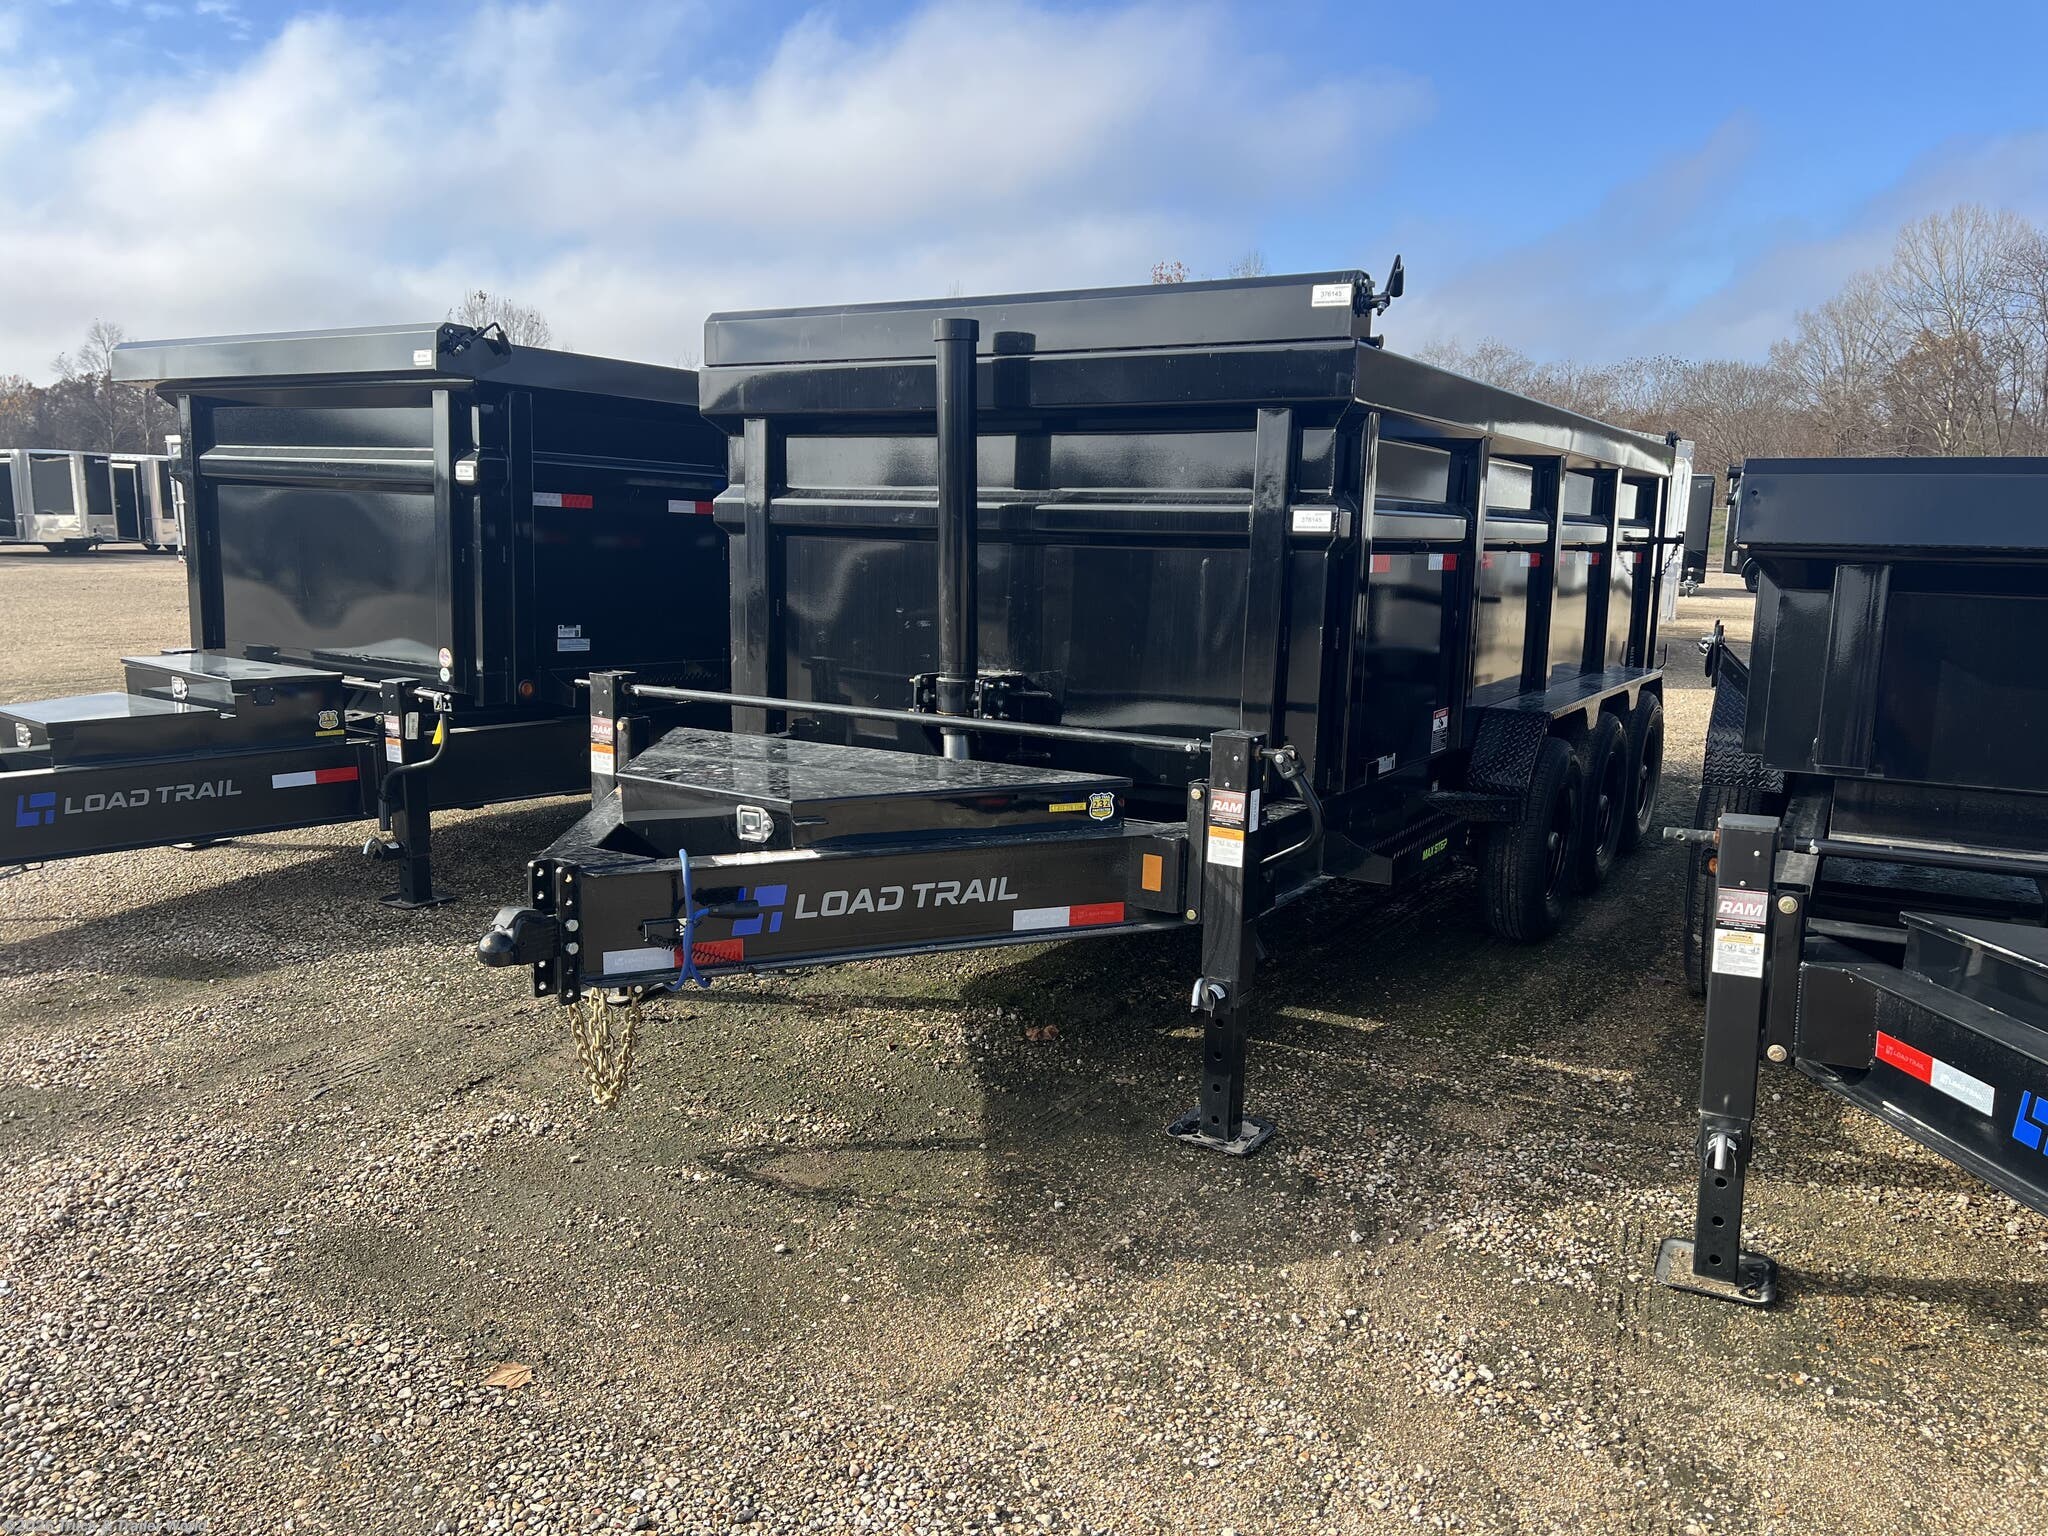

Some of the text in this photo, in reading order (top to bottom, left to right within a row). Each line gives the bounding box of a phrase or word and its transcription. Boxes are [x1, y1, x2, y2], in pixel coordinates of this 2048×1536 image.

[64, 788, 150, 815] LOAD
[155, 779, 243, 803] TRAIL
[1211, 799, 1243, 814] RAM
[794, 885, 905, 920] LOAD
[912, 876, 1018, 909] TRAIL
[1718, 900, 1764, 917] RAM
